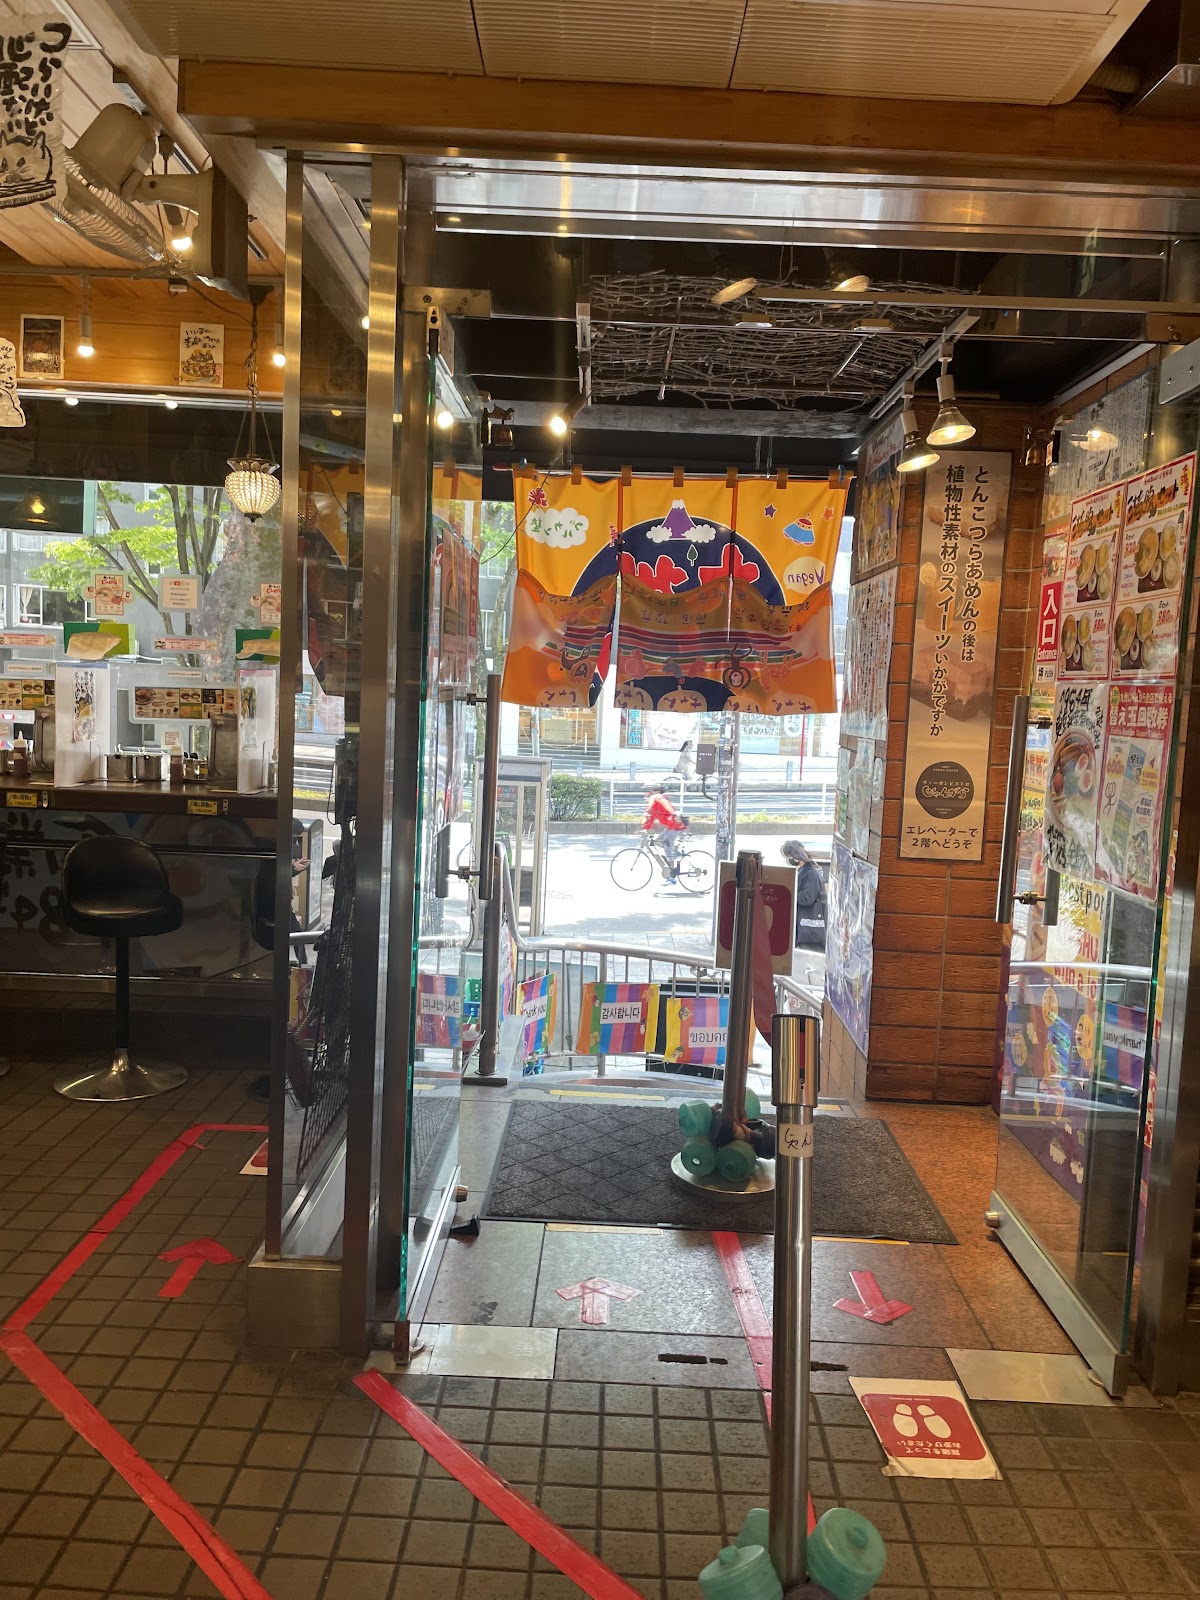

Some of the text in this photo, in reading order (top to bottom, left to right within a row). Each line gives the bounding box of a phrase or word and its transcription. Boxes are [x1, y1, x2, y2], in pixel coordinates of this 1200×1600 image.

[961, 465, 990, 662] とんこつらあめんの後は
[930, 464, 966, 737] 植物性素材のスイーツいかがですか
[1041, 588, 1058, 646] 入口
[906, 826, 979, 838] エレベーターで
[602, 1006, 641, 1020] 감사합니다
